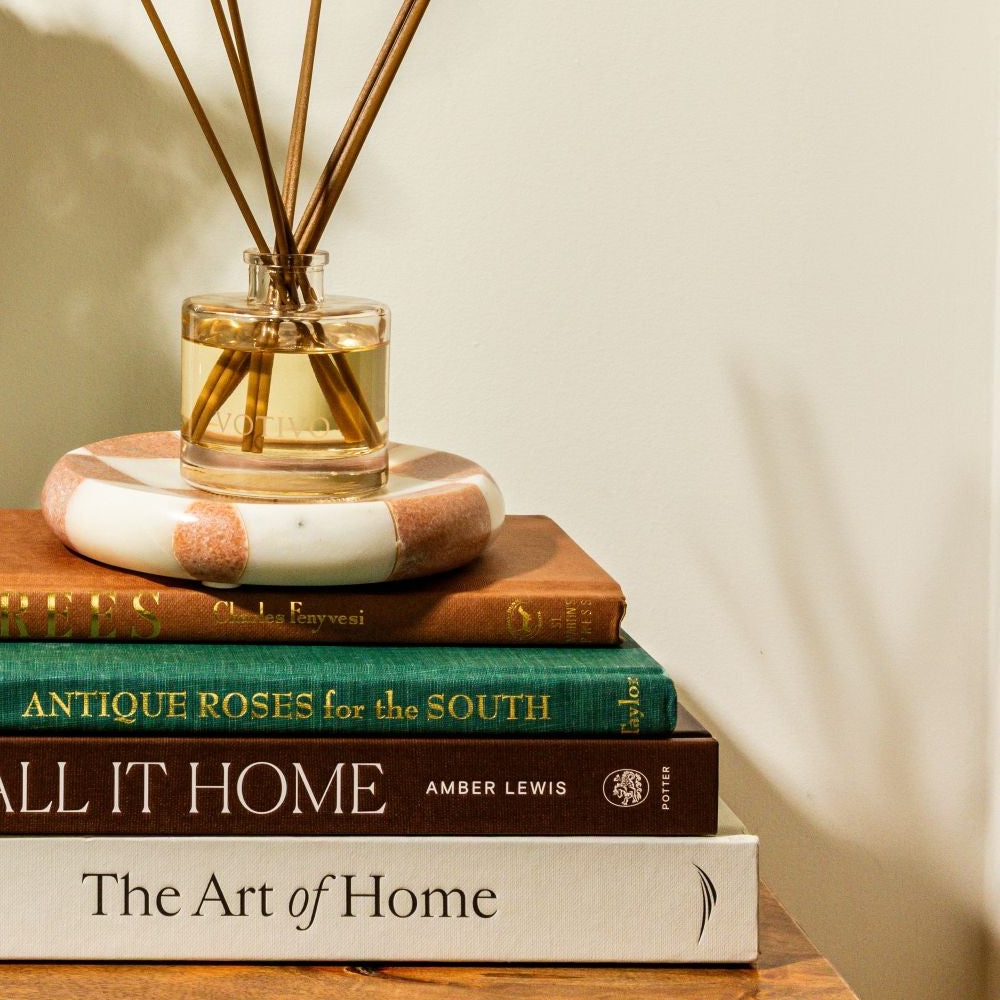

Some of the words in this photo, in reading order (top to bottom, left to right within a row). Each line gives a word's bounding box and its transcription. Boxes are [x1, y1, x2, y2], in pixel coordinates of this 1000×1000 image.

[216, 412, 330, 438] VOTIVO
[213, 601, 285, 624] Charles
[289, 601, 365, 634] Fenyvesi
[21, 690, 187, 724] ANTIQUE
[198, 691, 313, 720] ROSES
[323, 689, 365, 720] for
[375, 689, 419, 720] the
[426, 692, 551, 721] SOUTH
[617, 677, 646, 735] Taylor
[111, 761, 168, 813] IT
[188, 761, 387, 815] HOME
[425, 780, 496, 796] AMBER
[504, 780, 567, 796] LEWIS
[660, 765, 671, 811] POTTER
[81, 871, 182, 917] The
[190, 872, 274, 918] Art
[288, 873, 336, 931] of
[340, 873, 498, 919] Home
